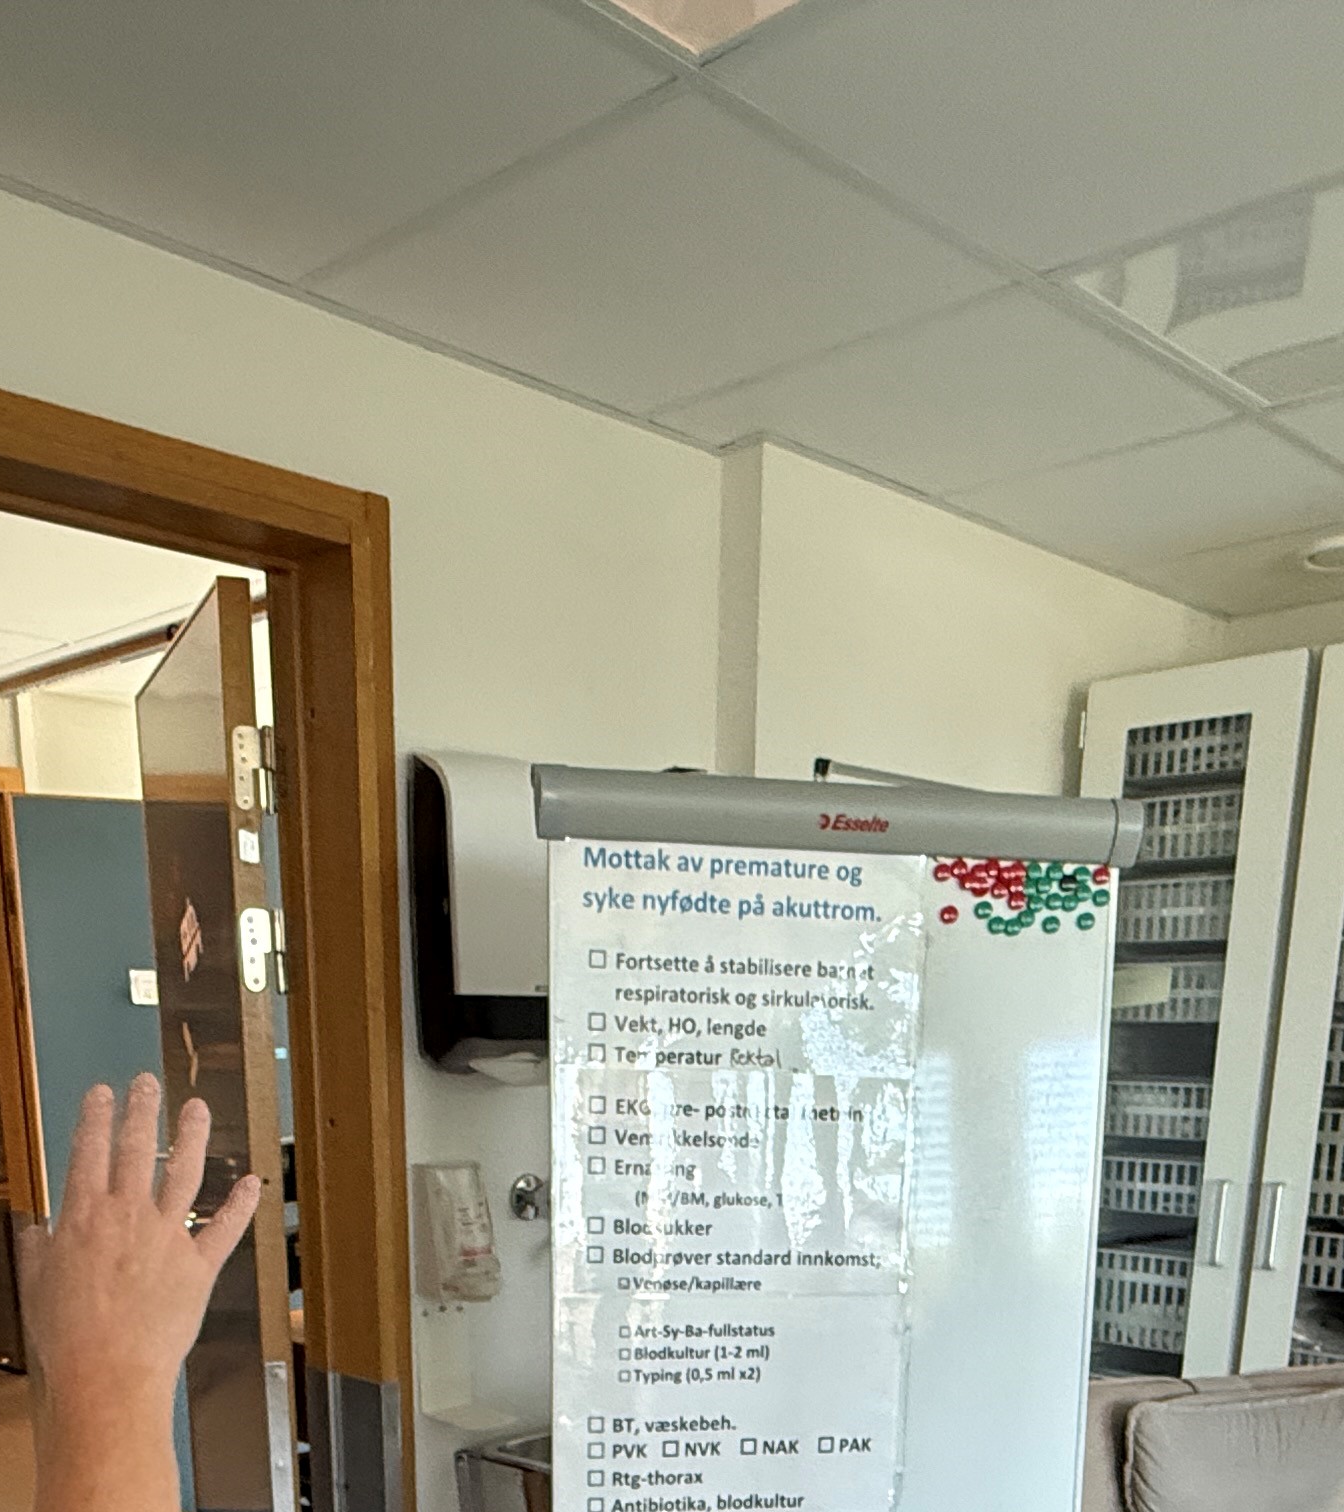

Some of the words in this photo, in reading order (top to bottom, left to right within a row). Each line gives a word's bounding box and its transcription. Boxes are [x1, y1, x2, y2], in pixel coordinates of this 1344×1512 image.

[583, 846, 669, 872] Mottak
[677, 855, 703, 873] av
[710, 858, 829, 879] premature
[837, 865, 862, 886] og
[583, 887, 635, 912] syke
[643, 890, 731, 916] nyfødte
[738, 894, 764, 920] på
[772, 896, 882, 922] akuttrom.
[616, 953, 699, 973] Fortsette
[704, 955, 714, 973] å
[720, 958, 811, 978] stabilisere
[615, 987, 730, 1006] respiratorisk
[735, 990, 756, 1010] og
[615, 1016, 662, 1035] Vekt,
[669, 1018, 701, 1036] HO,
[707, 1018, 767, 1039] lengde
[714, 1193, 773, 1209] glukose,
[716, 1250, 791, 1266] standard
[634, 1277, 761, 1292] Venøse/kapillære
[634, 1325, 775, 1341] Art-Sy-Ba-fullstatus
[634, 1347, 710, 1361] Blodkultur
[714, 1346, 742, 1361] (1-2
[747, 1346, 770, 1361] ml)
[634, 1369, 682, 1384] Typing
[686, 1368, 712, 1384] (0,5
[717, 1367, 735, 1381] ml
[739, 1367, 761, 1382] x2)
[613, 1418, 639, 1435] BT,
[646, 1416, 737, 1432] væskebeh.
[612, 1443, 647, 1459] PVK
[685, 1441, 720, 1457] NVK
[763, 1440, 799, 1454] NAK
[840, 1438, 871, 1452] PAK
[612, 1471, 703, 1489] Rtg-thorax
[717, 1494, 804, 1511] blodkultur
